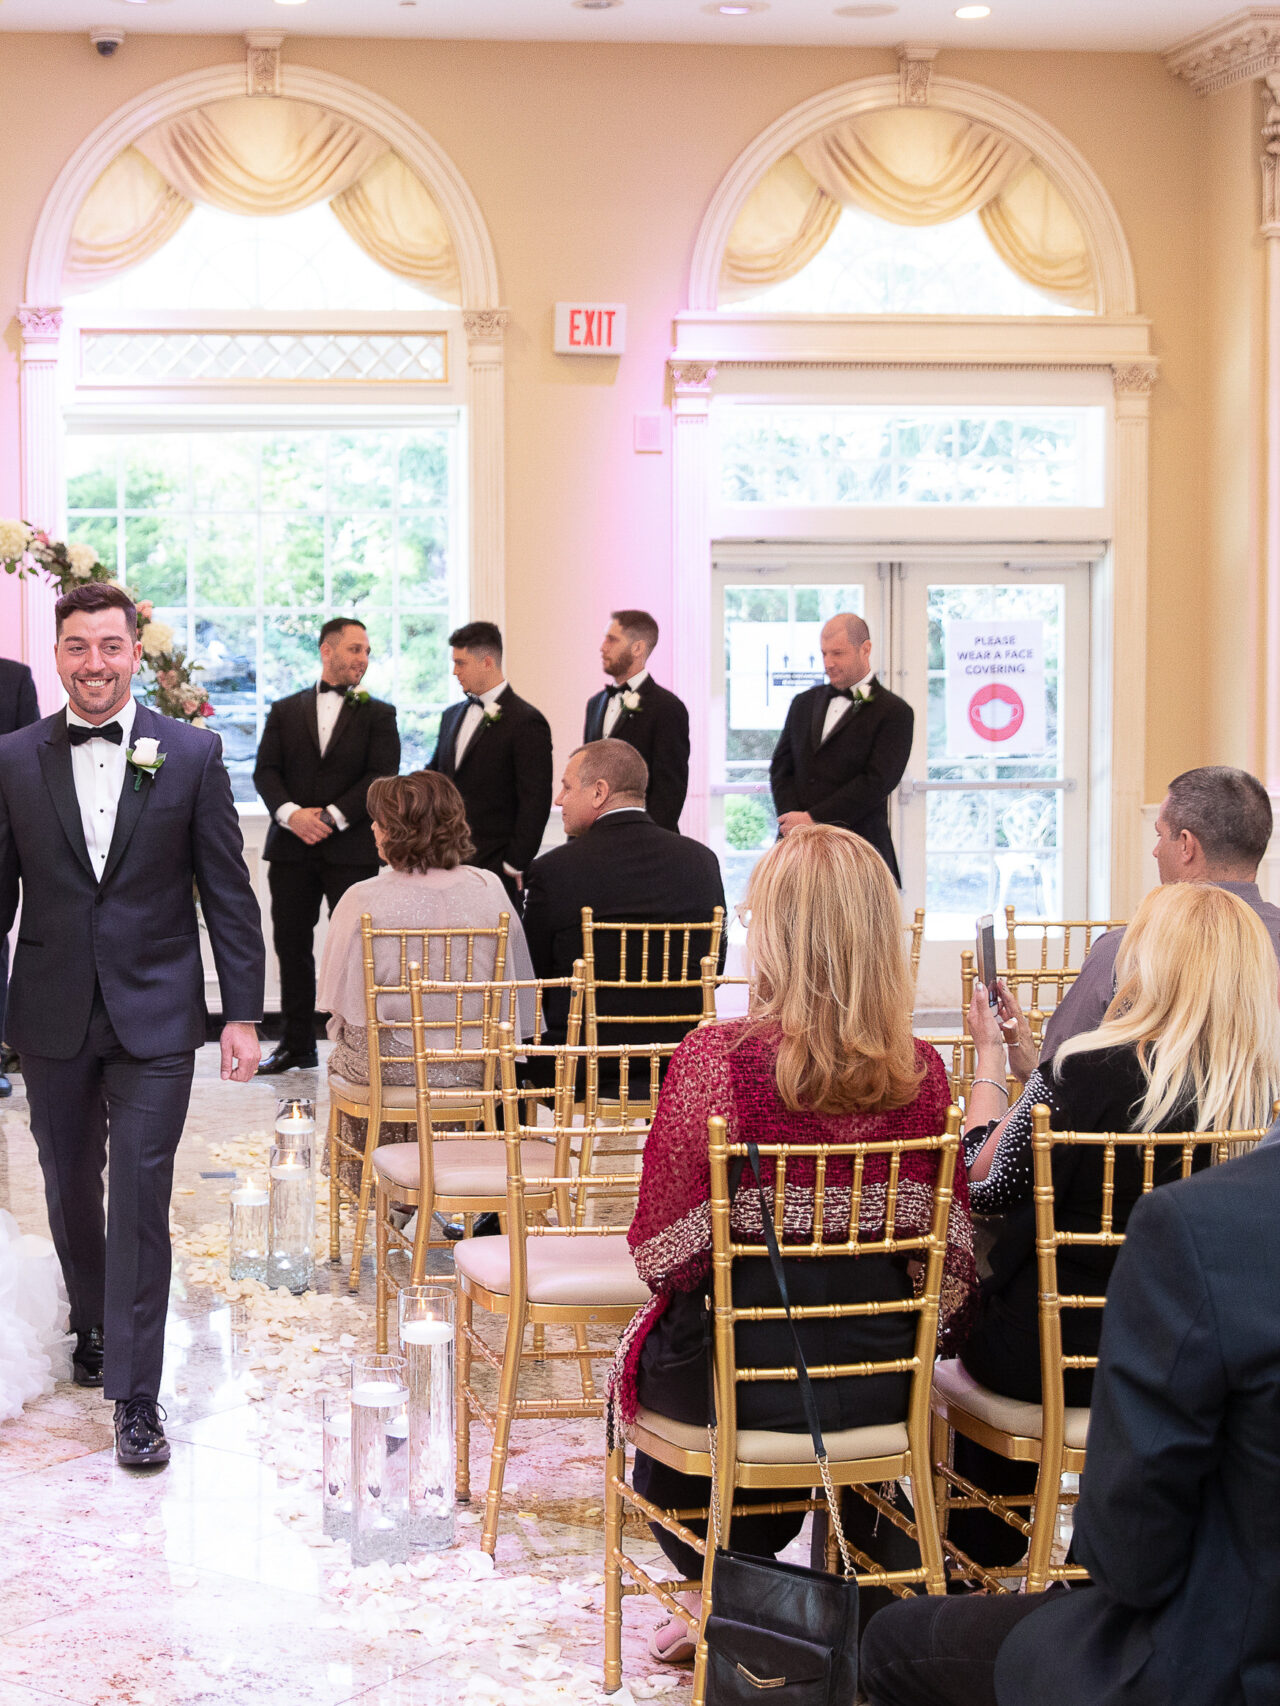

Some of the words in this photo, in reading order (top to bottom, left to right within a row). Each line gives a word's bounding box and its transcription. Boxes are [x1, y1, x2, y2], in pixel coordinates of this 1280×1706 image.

[569, 309, 616, 347] EXIT
[975, 636, 1015, 645] PLEASE
[958, 651, 991, 660] WEAR
[993, 651, 1001, 660] A
[1005, 649, 1032, 659] FACE
[966, 664, 1025, 674] COVERING
